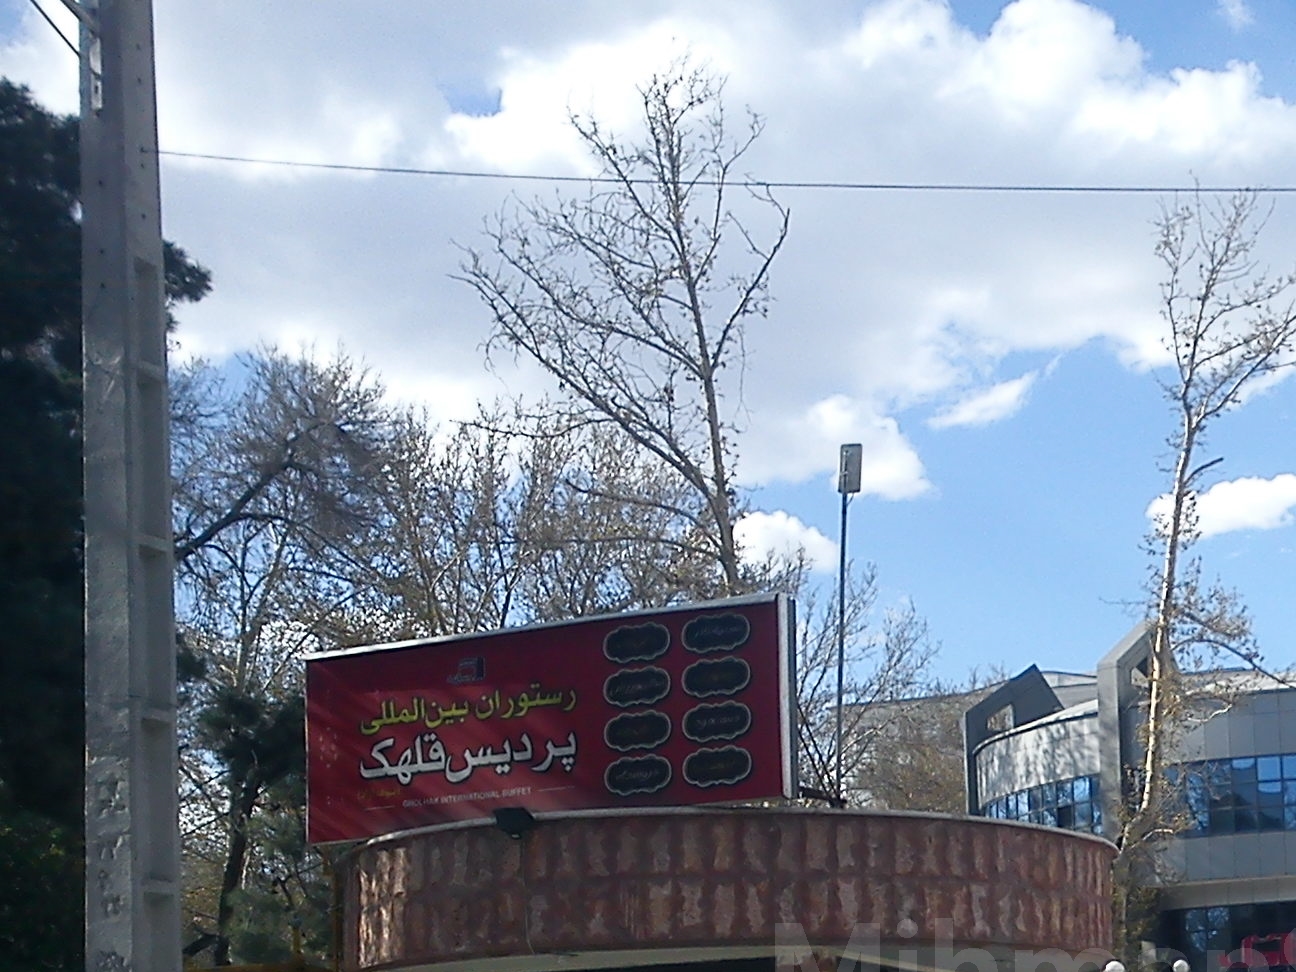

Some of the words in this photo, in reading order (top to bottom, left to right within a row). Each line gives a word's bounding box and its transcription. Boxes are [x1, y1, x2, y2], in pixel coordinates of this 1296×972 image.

[475, 682, 577, 719] رستوران
[359, 731, 446, 785] قلهک
[446, 731, 578, 783] پردیس
[440, 790, 501, 804] INTERNATIONAL
[501, 786, 532, 797] BUFFET
